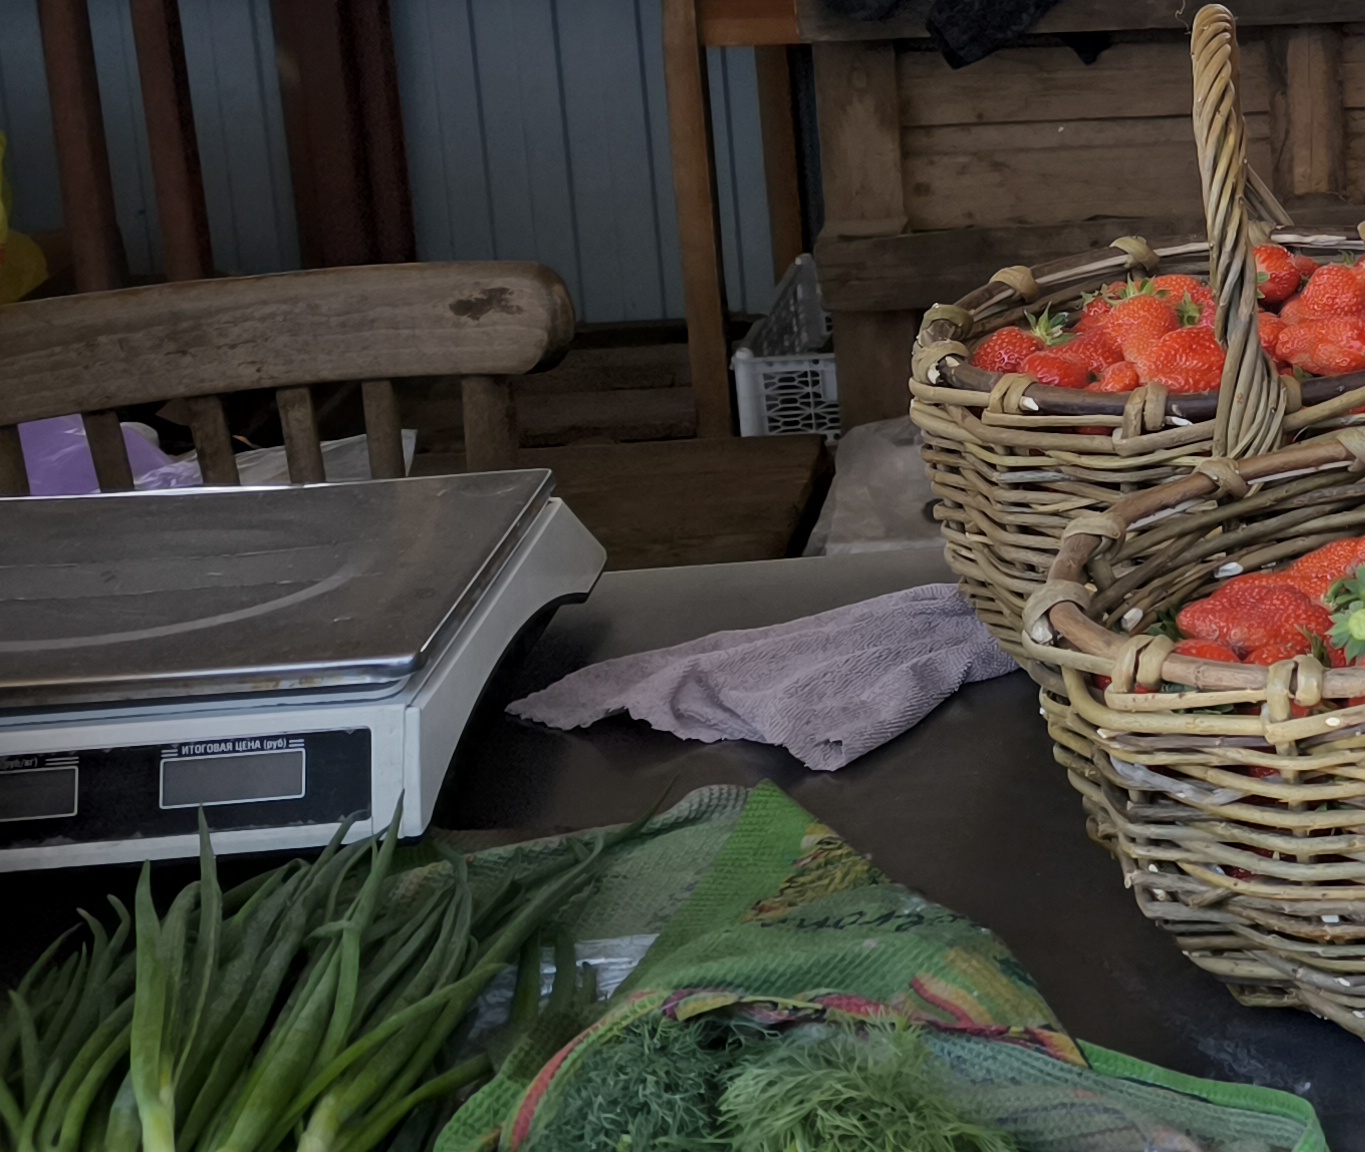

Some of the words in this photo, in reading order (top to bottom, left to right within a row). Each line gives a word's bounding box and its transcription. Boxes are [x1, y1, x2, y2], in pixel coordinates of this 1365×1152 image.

[181, 742, 233, 755] ИТОГОВАЯ
[235, 740, 261, 753] ЦЕНА
[263, 738, 287, 751] (руб)
